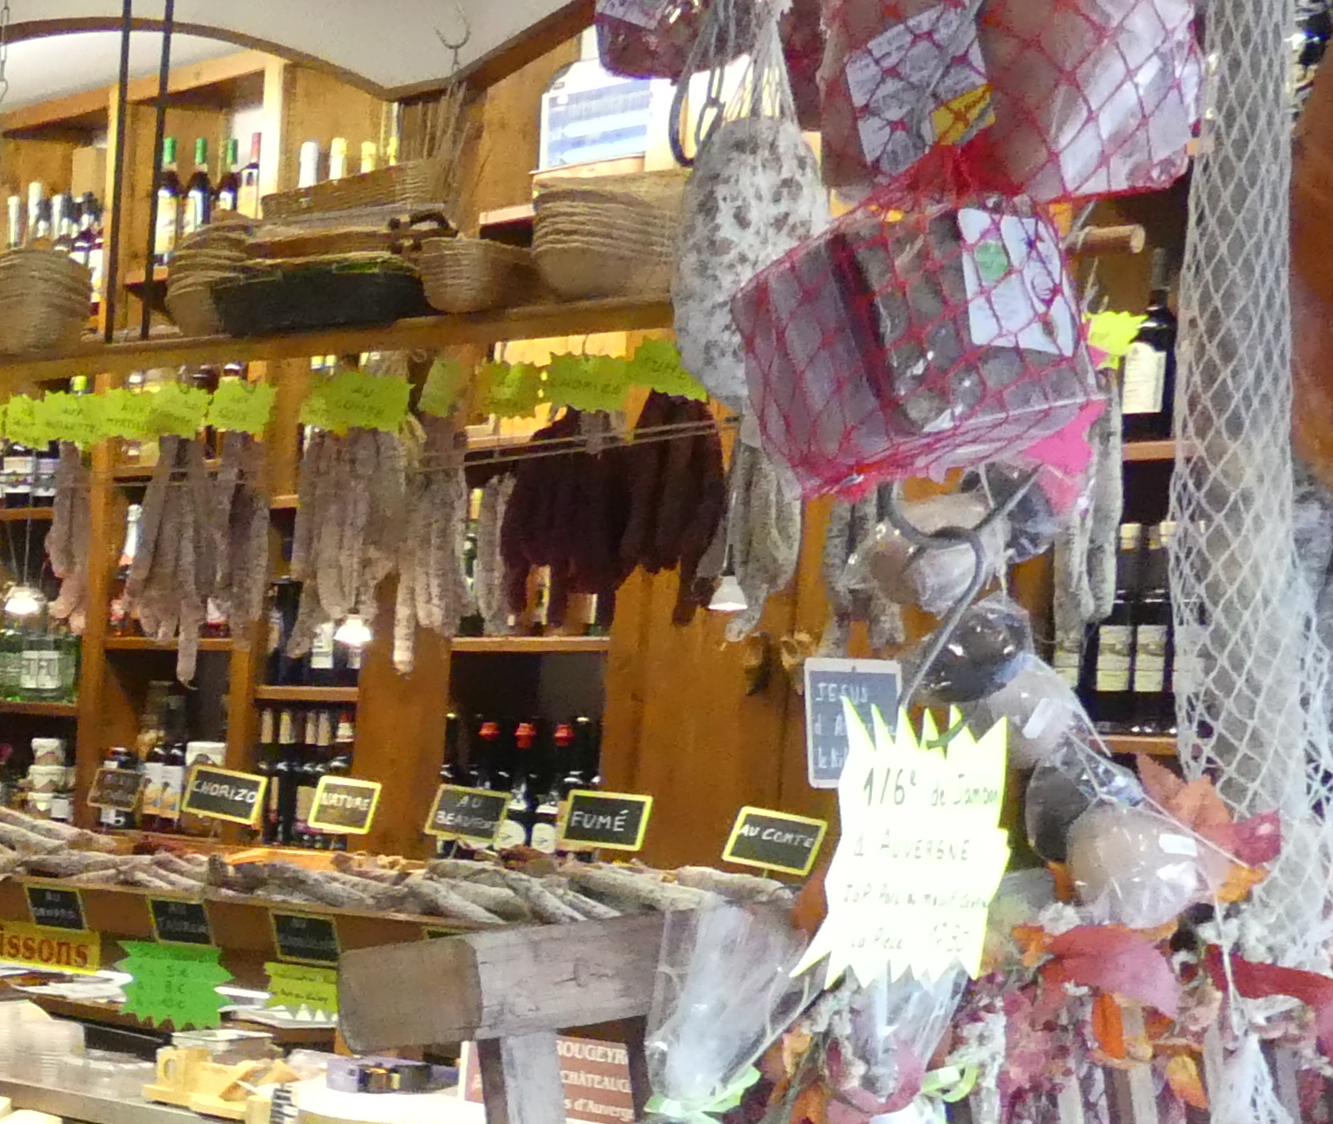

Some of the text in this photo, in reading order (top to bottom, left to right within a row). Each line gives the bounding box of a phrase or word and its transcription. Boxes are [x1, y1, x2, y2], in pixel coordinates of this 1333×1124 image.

[190, 778, 258, 804] CHORIZO
[457, 794, 483, 808] AU
[571, 809, 629, 832] FUMÉ
[739, 823, 761, 838] AU
